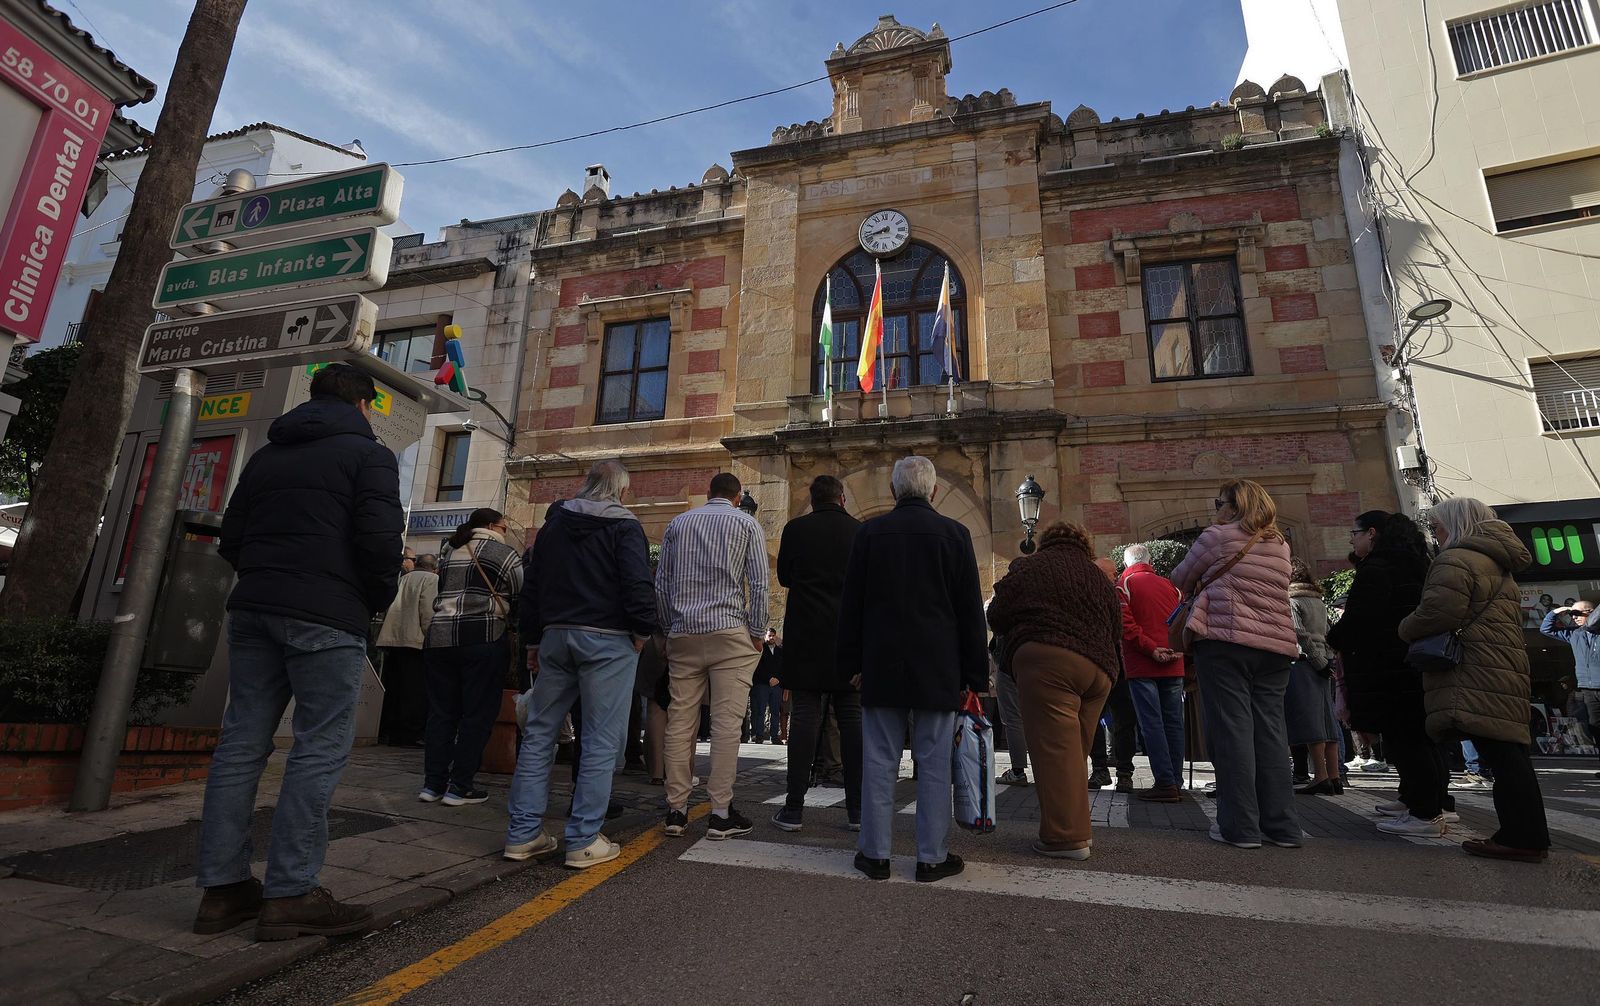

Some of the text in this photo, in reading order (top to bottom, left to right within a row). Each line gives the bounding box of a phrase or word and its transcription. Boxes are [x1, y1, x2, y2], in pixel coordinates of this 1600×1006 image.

[2, 46, 100, 126] 58 70 01
[37, 127, 85, 221] Dental
[811, 180, 848, 197] CASA
[279, 184, 374, 215] Plaza Alta
[166, 254, 326, 293] avda. Blas Infante
[147, 334, 268, 363] María Cristina
[153, 323, 200, 344] parque
[200, 396, 242, 417] NCE
